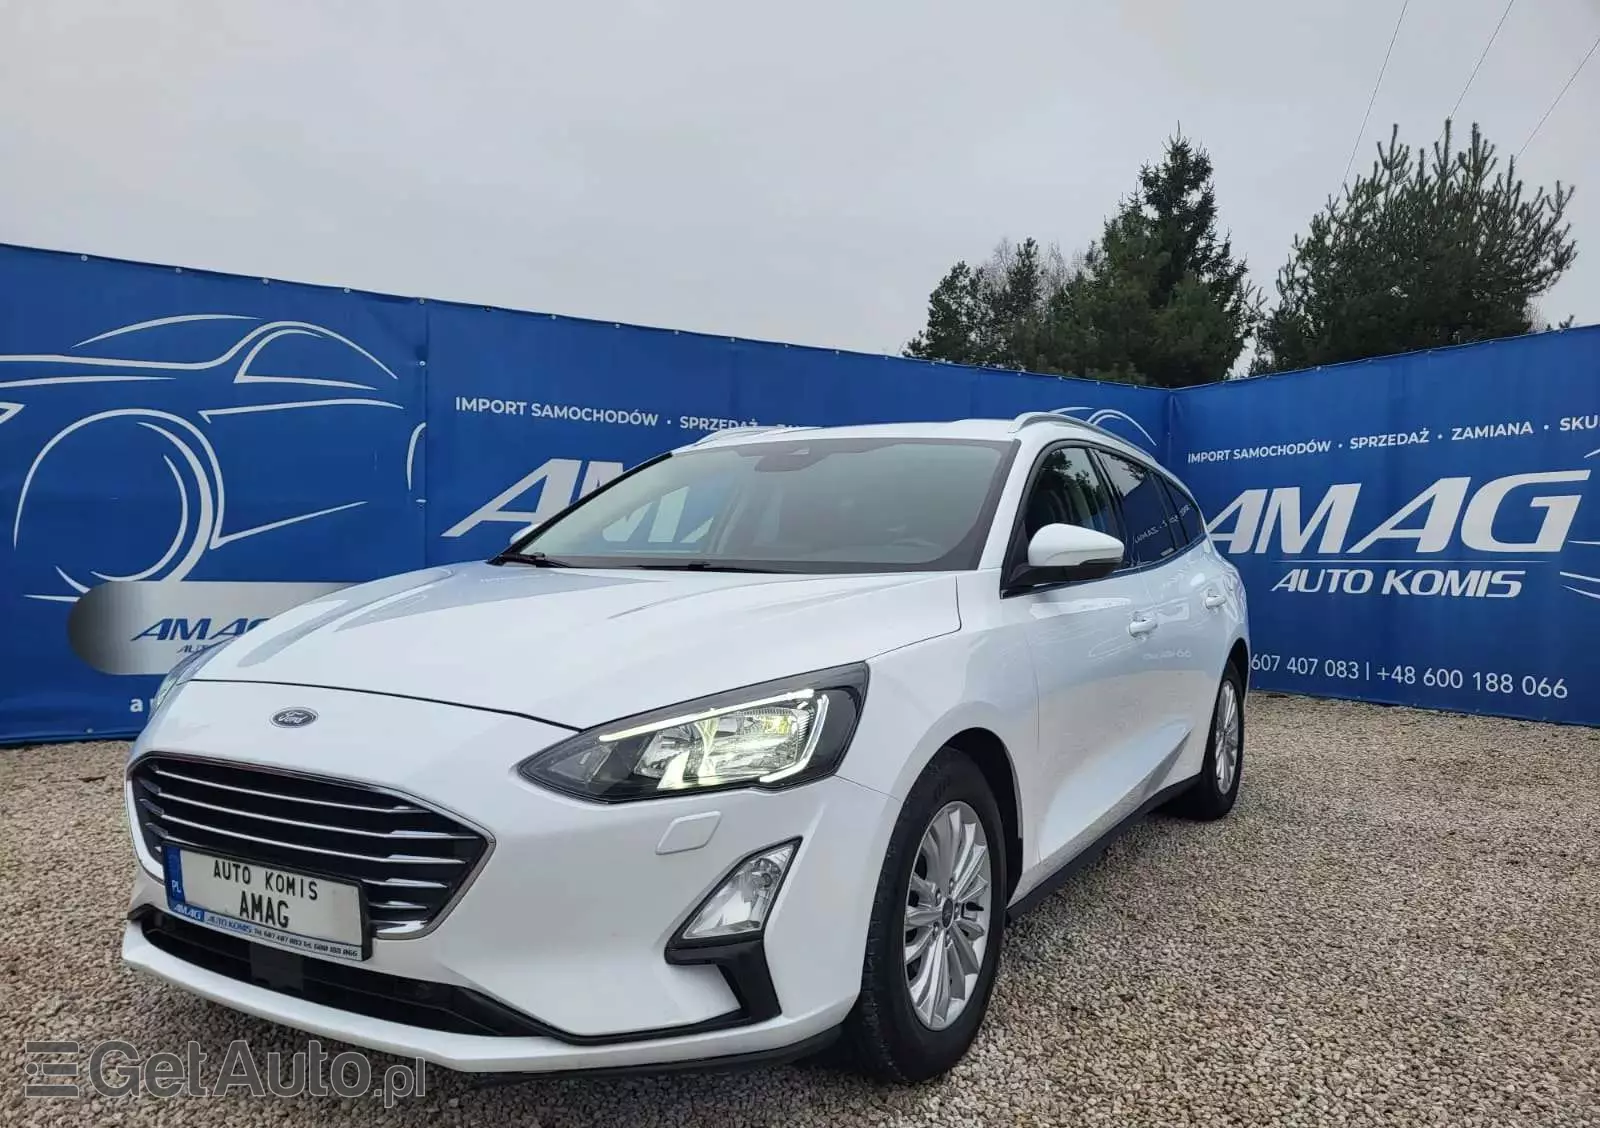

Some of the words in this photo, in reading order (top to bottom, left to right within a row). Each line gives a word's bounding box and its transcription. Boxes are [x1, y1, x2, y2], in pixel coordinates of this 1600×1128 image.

[455, 396, 527, 416] IMPORT
[531, 402, 659, 427] SAMOCHODÓW
[1188, 449, 1231, 464] IMPORT
[1233, 439, 1332, 460] SAMOCHODÓW
[1350, 428, 1430, 450] SPRZEDAŻ
[1451, 421, 1534, 441] ZAMIANA
[1560, 414, 1600, 431] SKU
[1203, 469, 1591, 554] AMAG
[1271, 568, 1374, 594] AUTO
[1381, 569, 1526, 598] KOMIS
[1251, 653, 1281, 671] 607
[1286, 657, 1318, 675] 407
[1324, 659, 1359, 679] 083
[1377, 665, 1416, 684] +48
[1423, 667, 1463, 689] 600
[1472, 671, 1513, 693] 188
[1522, 675, 1568, 699] 066
[213, 859, 251, 885] AUTO
[264, 871, 318, 901] KOMIS
[239, 890, 290, 928] AMAG
